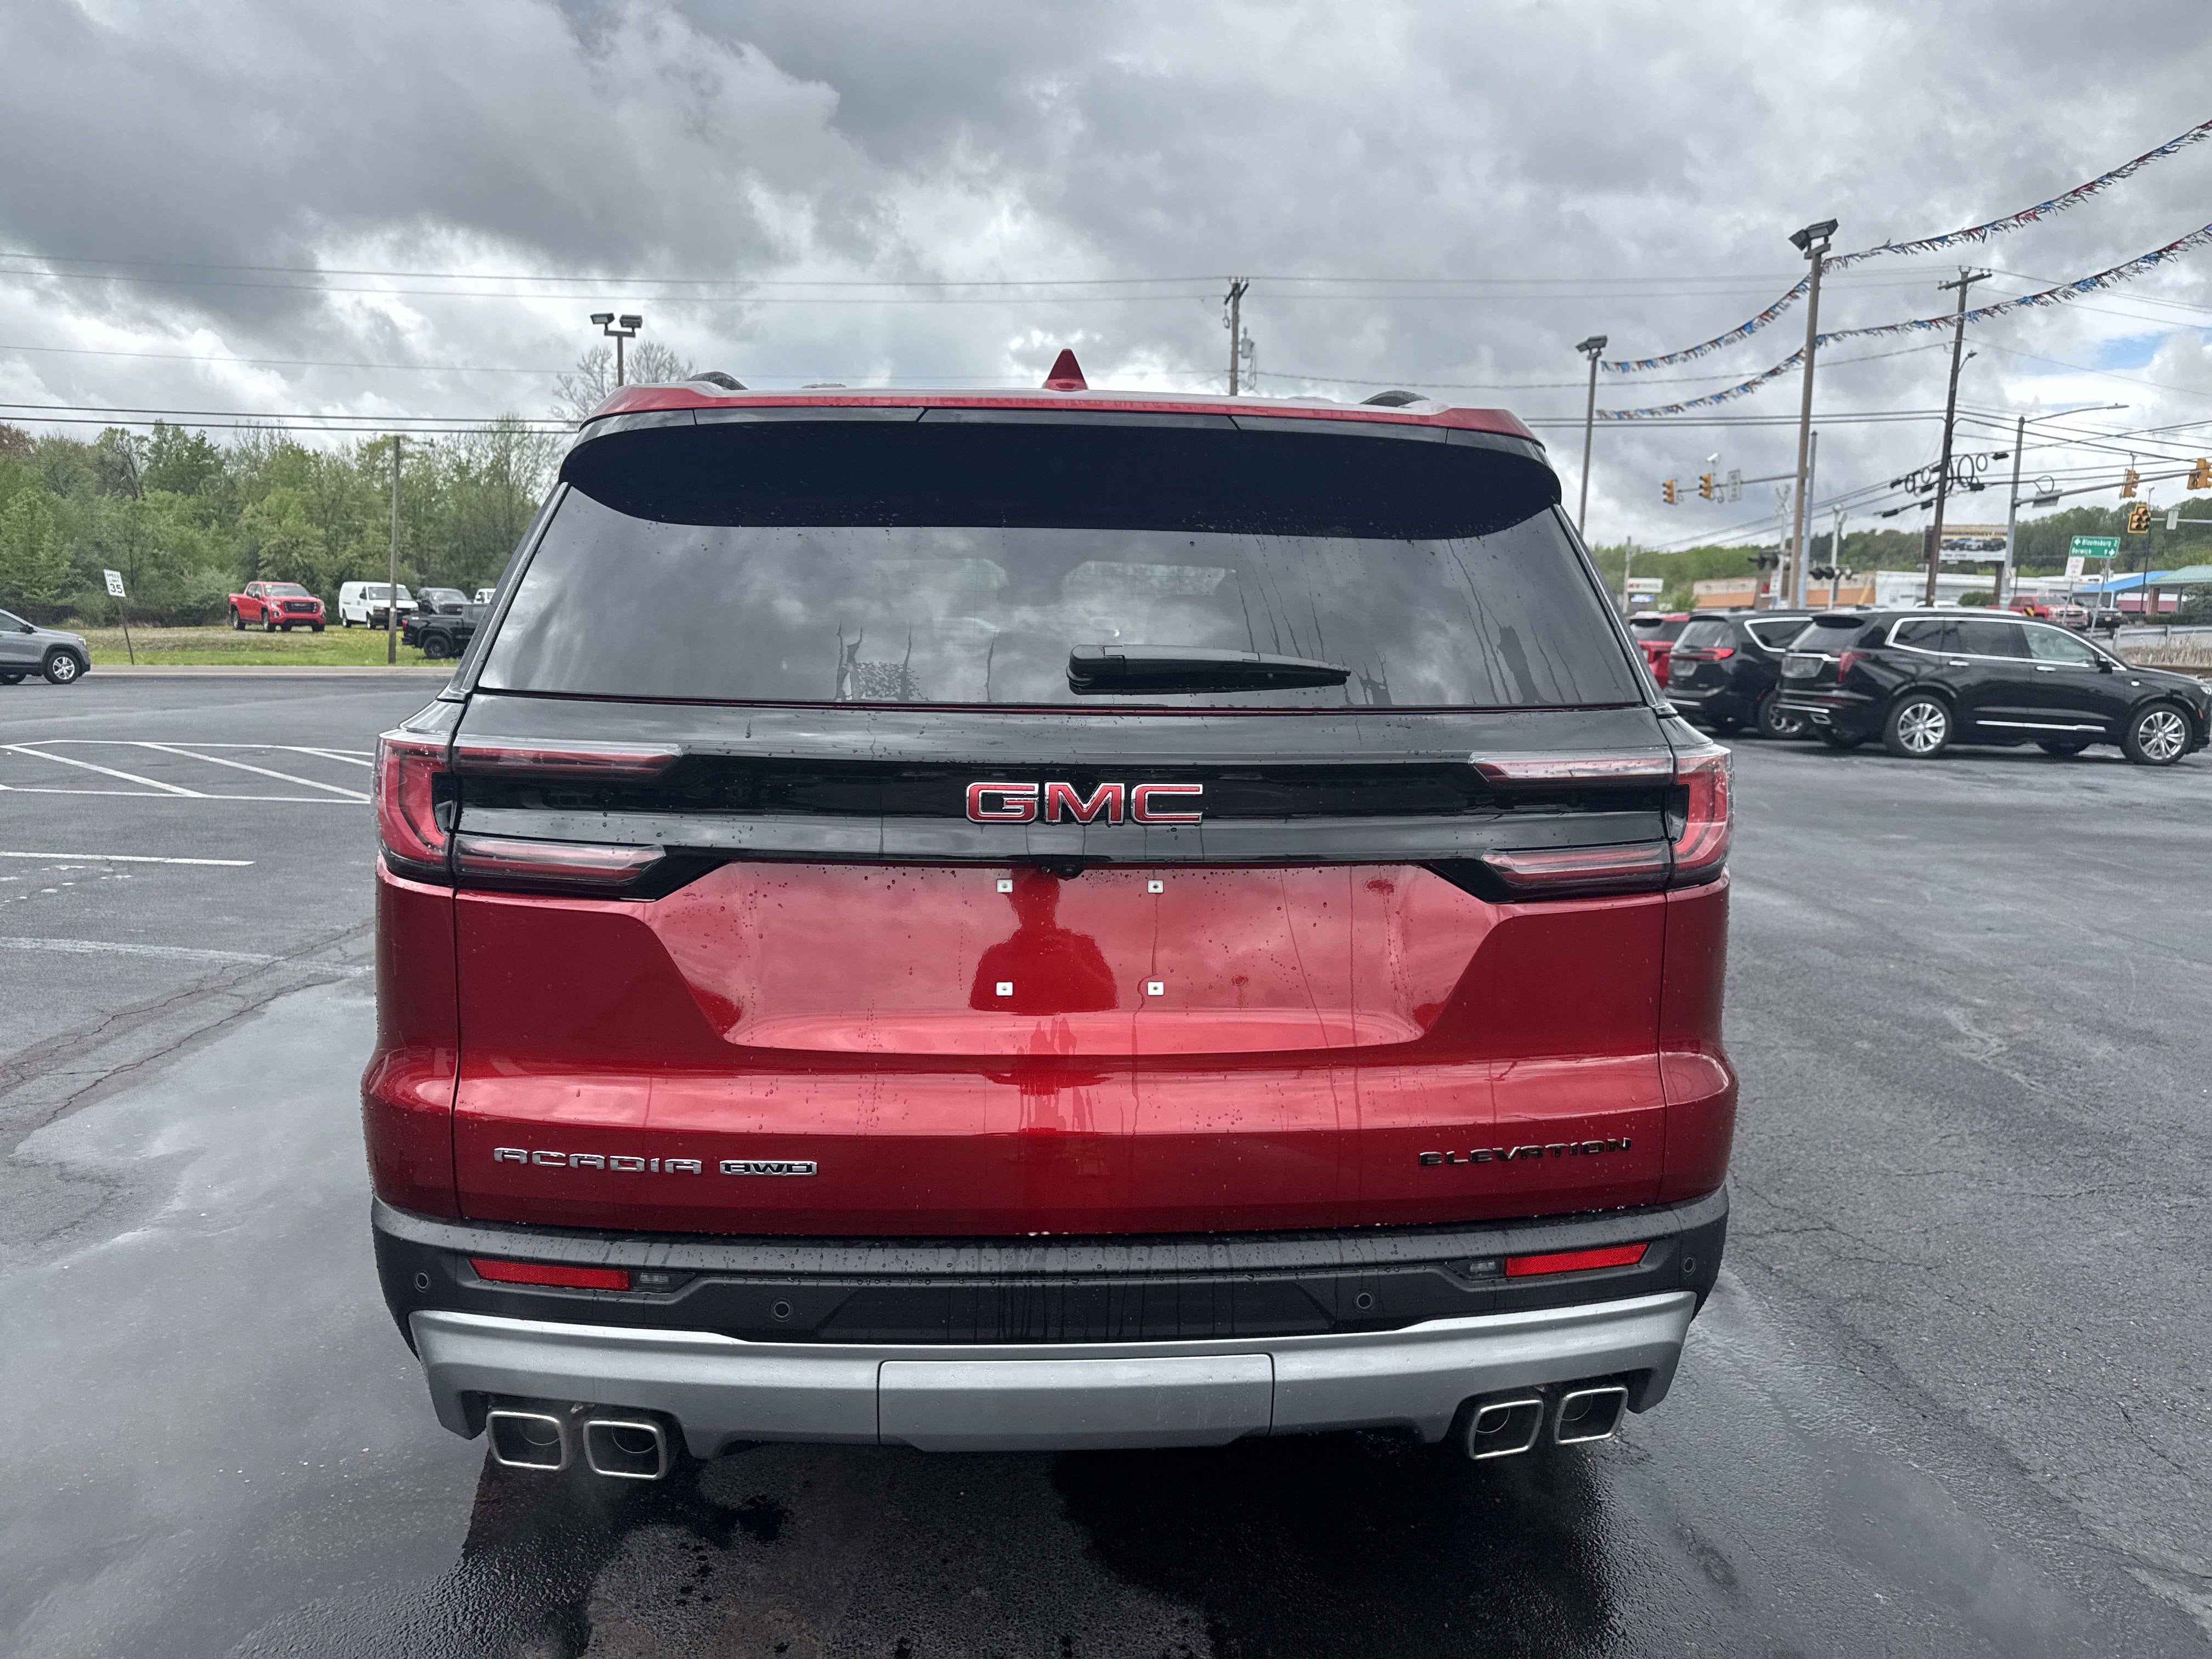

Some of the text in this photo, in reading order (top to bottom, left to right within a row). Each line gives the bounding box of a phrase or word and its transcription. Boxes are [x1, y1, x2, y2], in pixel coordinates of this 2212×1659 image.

[2082, 539, 2111, 548] Bloomsburg
[110, 583, 122, 594] 35
[966, 781, 1203, 823] GMC
[494, 1147, 817, 1176] ACADIA AWD
[1419, 1137, 1632, 1166] ELEVATION
